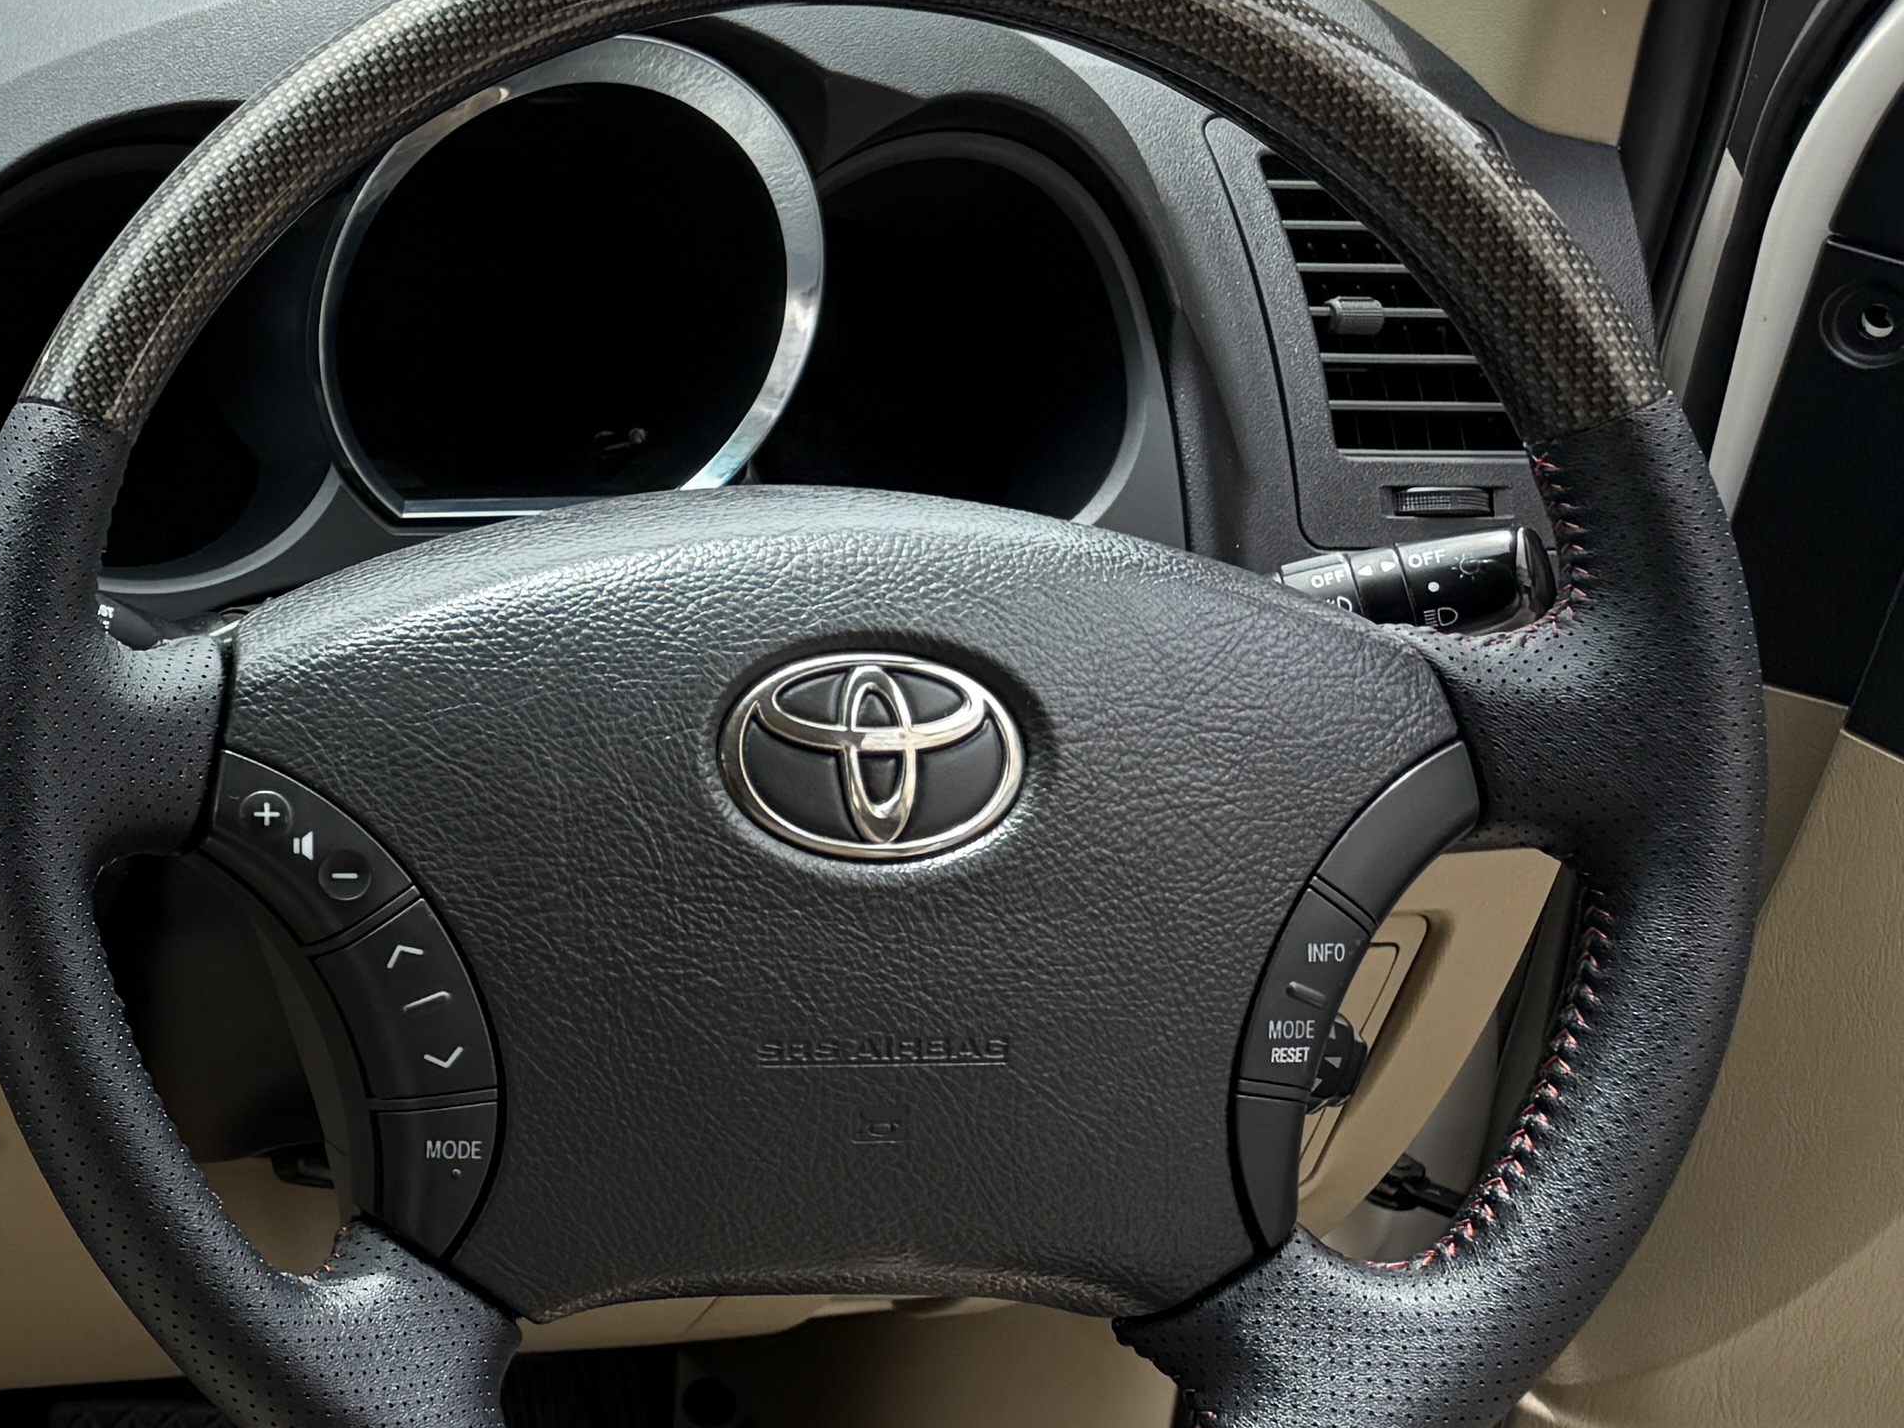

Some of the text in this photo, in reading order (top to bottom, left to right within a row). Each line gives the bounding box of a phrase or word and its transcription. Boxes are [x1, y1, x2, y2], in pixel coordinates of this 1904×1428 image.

[1408, 549, 1446, 569] OFF
[1310, 570, 1345, 589] OFF
[1307, 943, 1346, 963] INFO
[1268, 1020, 1315, 1039] MODE
[1271, 1046, 1310, 1063] RESET
[424, 1139, 483, 1161] MODE
